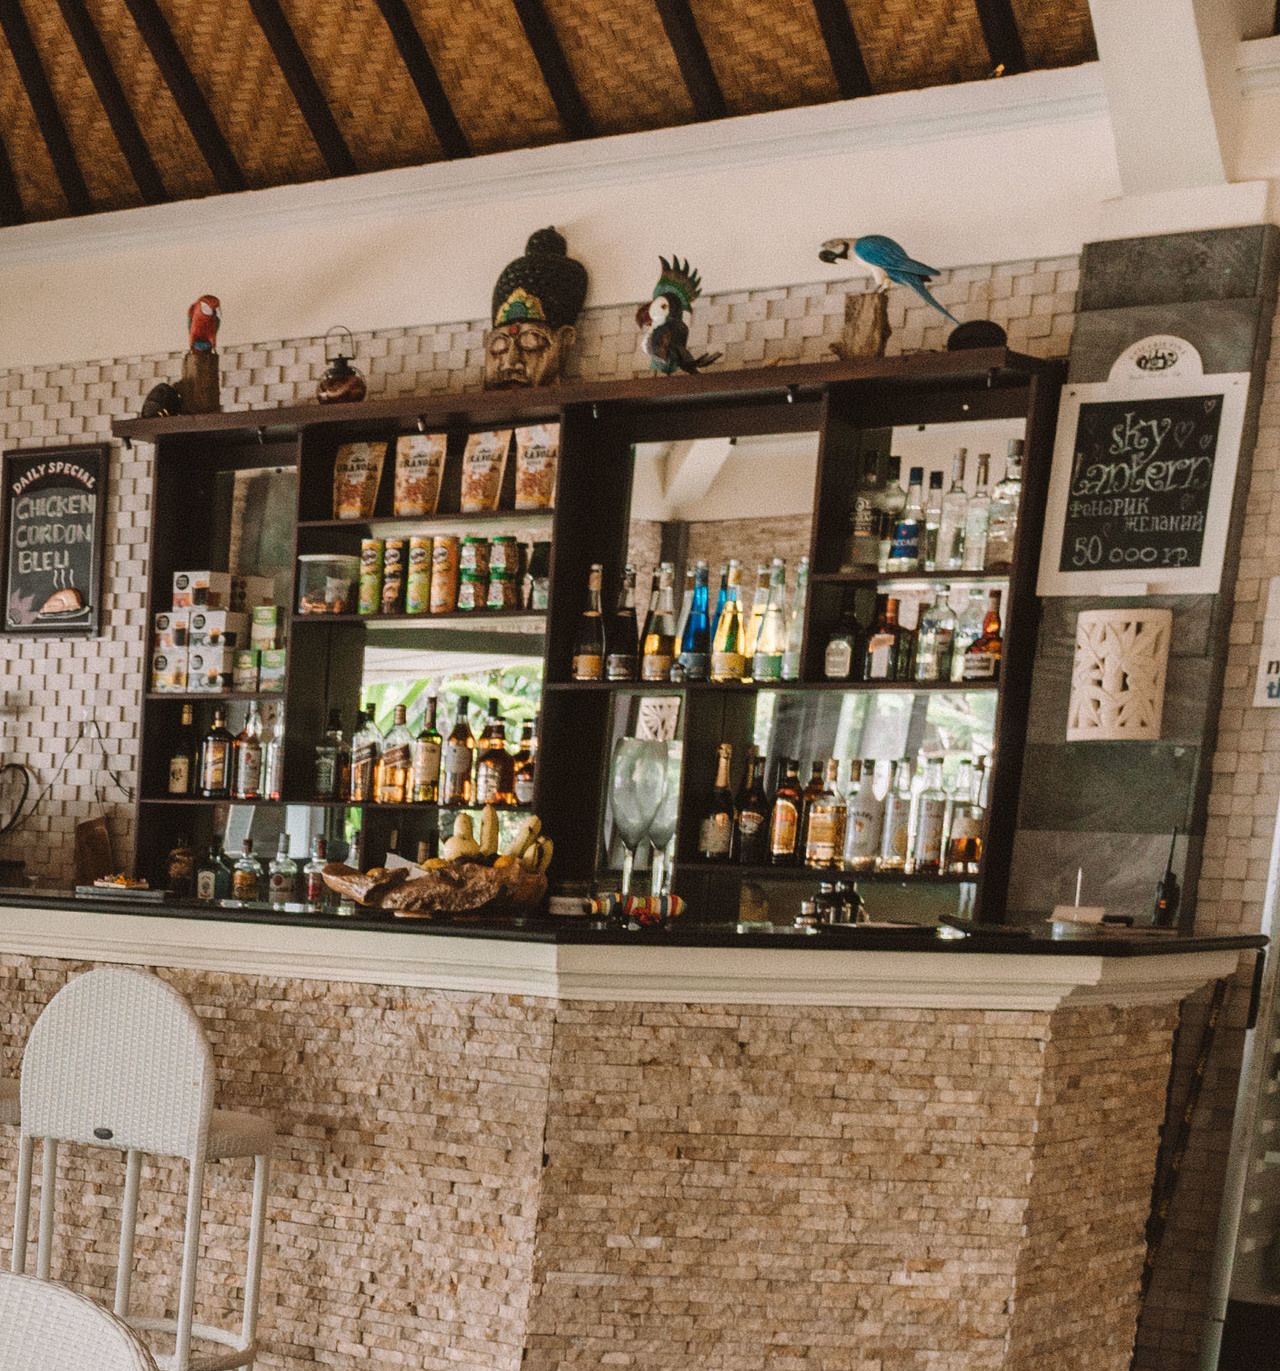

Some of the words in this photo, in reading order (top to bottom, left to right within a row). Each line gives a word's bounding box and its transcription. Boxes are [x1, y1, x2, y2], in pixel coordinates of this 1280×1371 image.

[399, 458, 440, 468] RANOLA
[12, 463, 46, 496] DAILY
[48, 461, 97, 489] SPECIAL
[16, 494, 95, 521] CHICKEN
[16, 523, 91, 548] CORDON
[18, 550, 70, 574] BLEU
[1072, 535, 1102, 566] 50
[1109, 547, 1158, 562] 000
